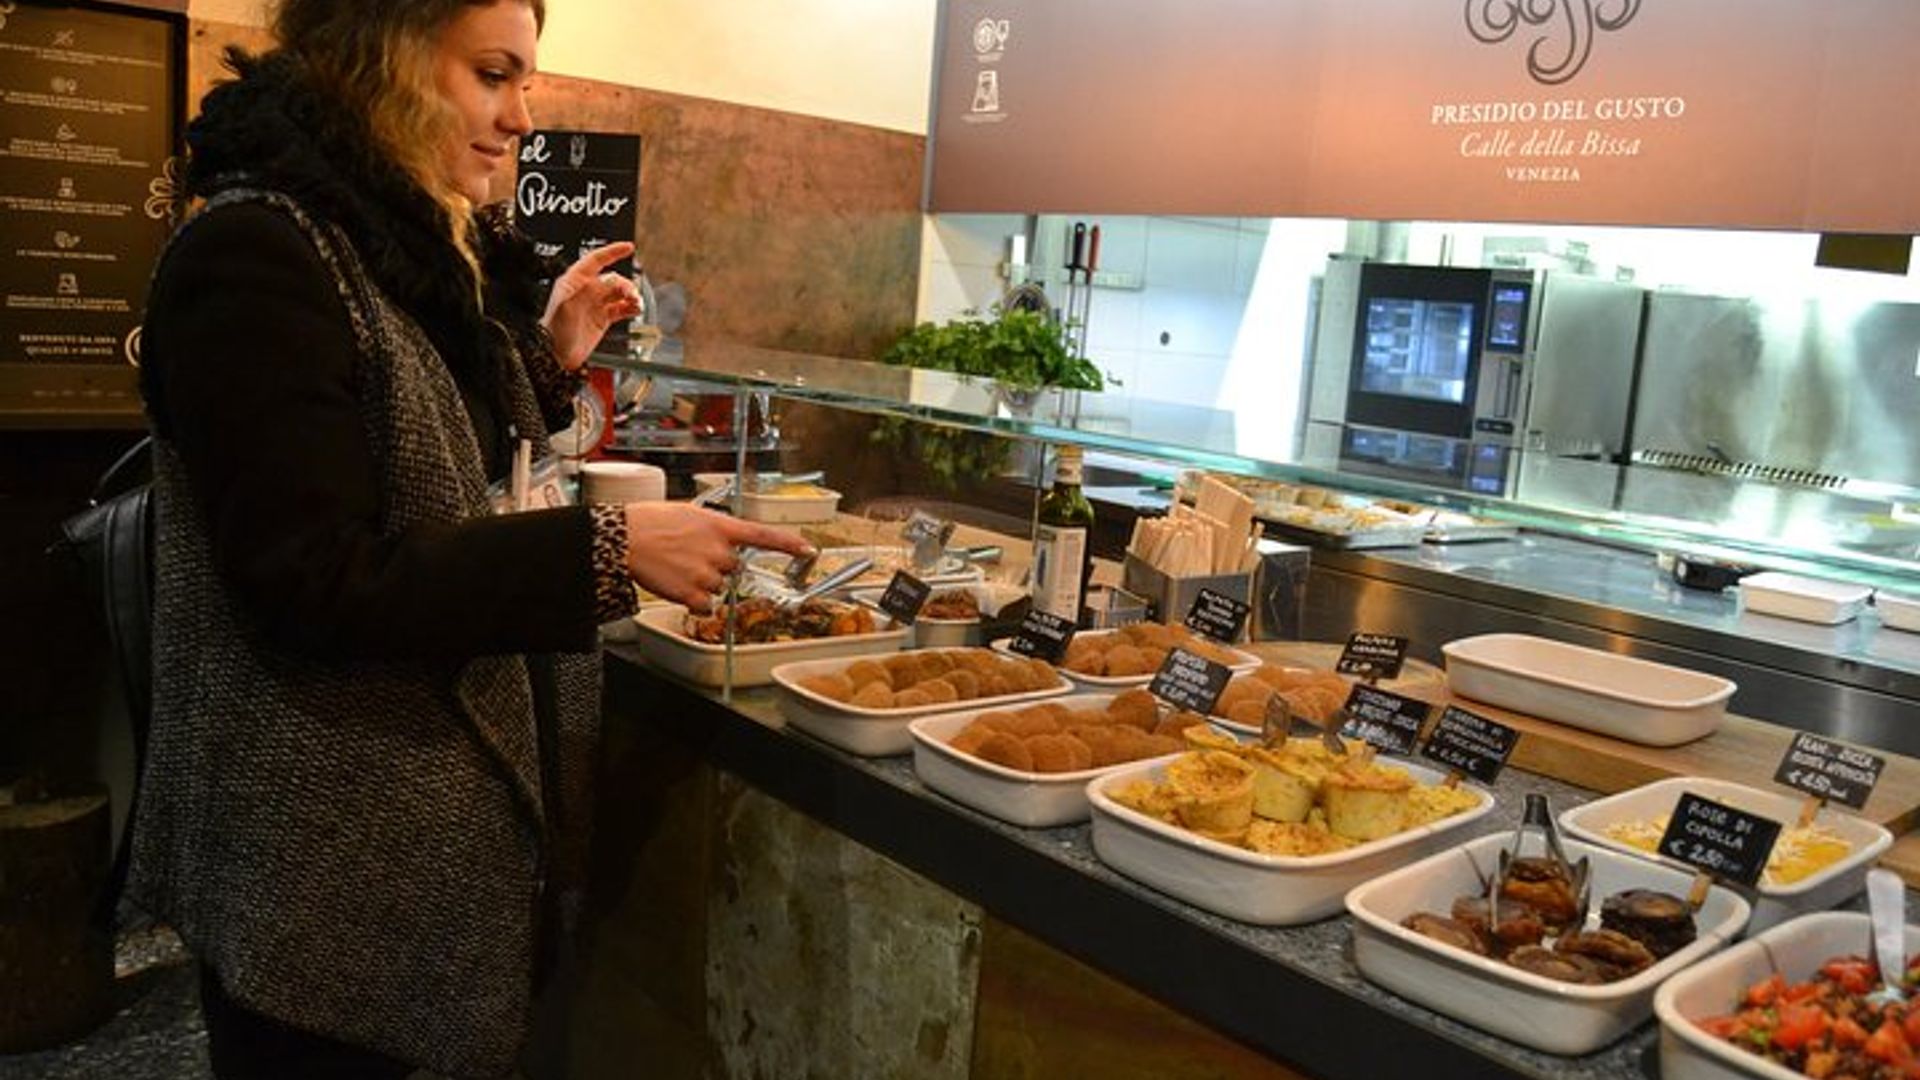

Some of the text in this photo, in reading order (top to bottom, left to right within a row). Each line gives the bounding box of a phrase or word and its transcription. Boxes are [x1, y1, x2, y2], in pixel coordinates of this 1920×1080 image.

[1430, 96, 1685, 125] PRESIDIO DEL GUSTO
[1460, 129, 1642, 158] Calle della Bissa
[1505, 166, 1581, 182] VENEZIA
[517, 172, 628, 216] Risotto
[1687, 801, 1754, 835] ROSE DI
[1685, 820, 1744, 850] CIPOLLA
